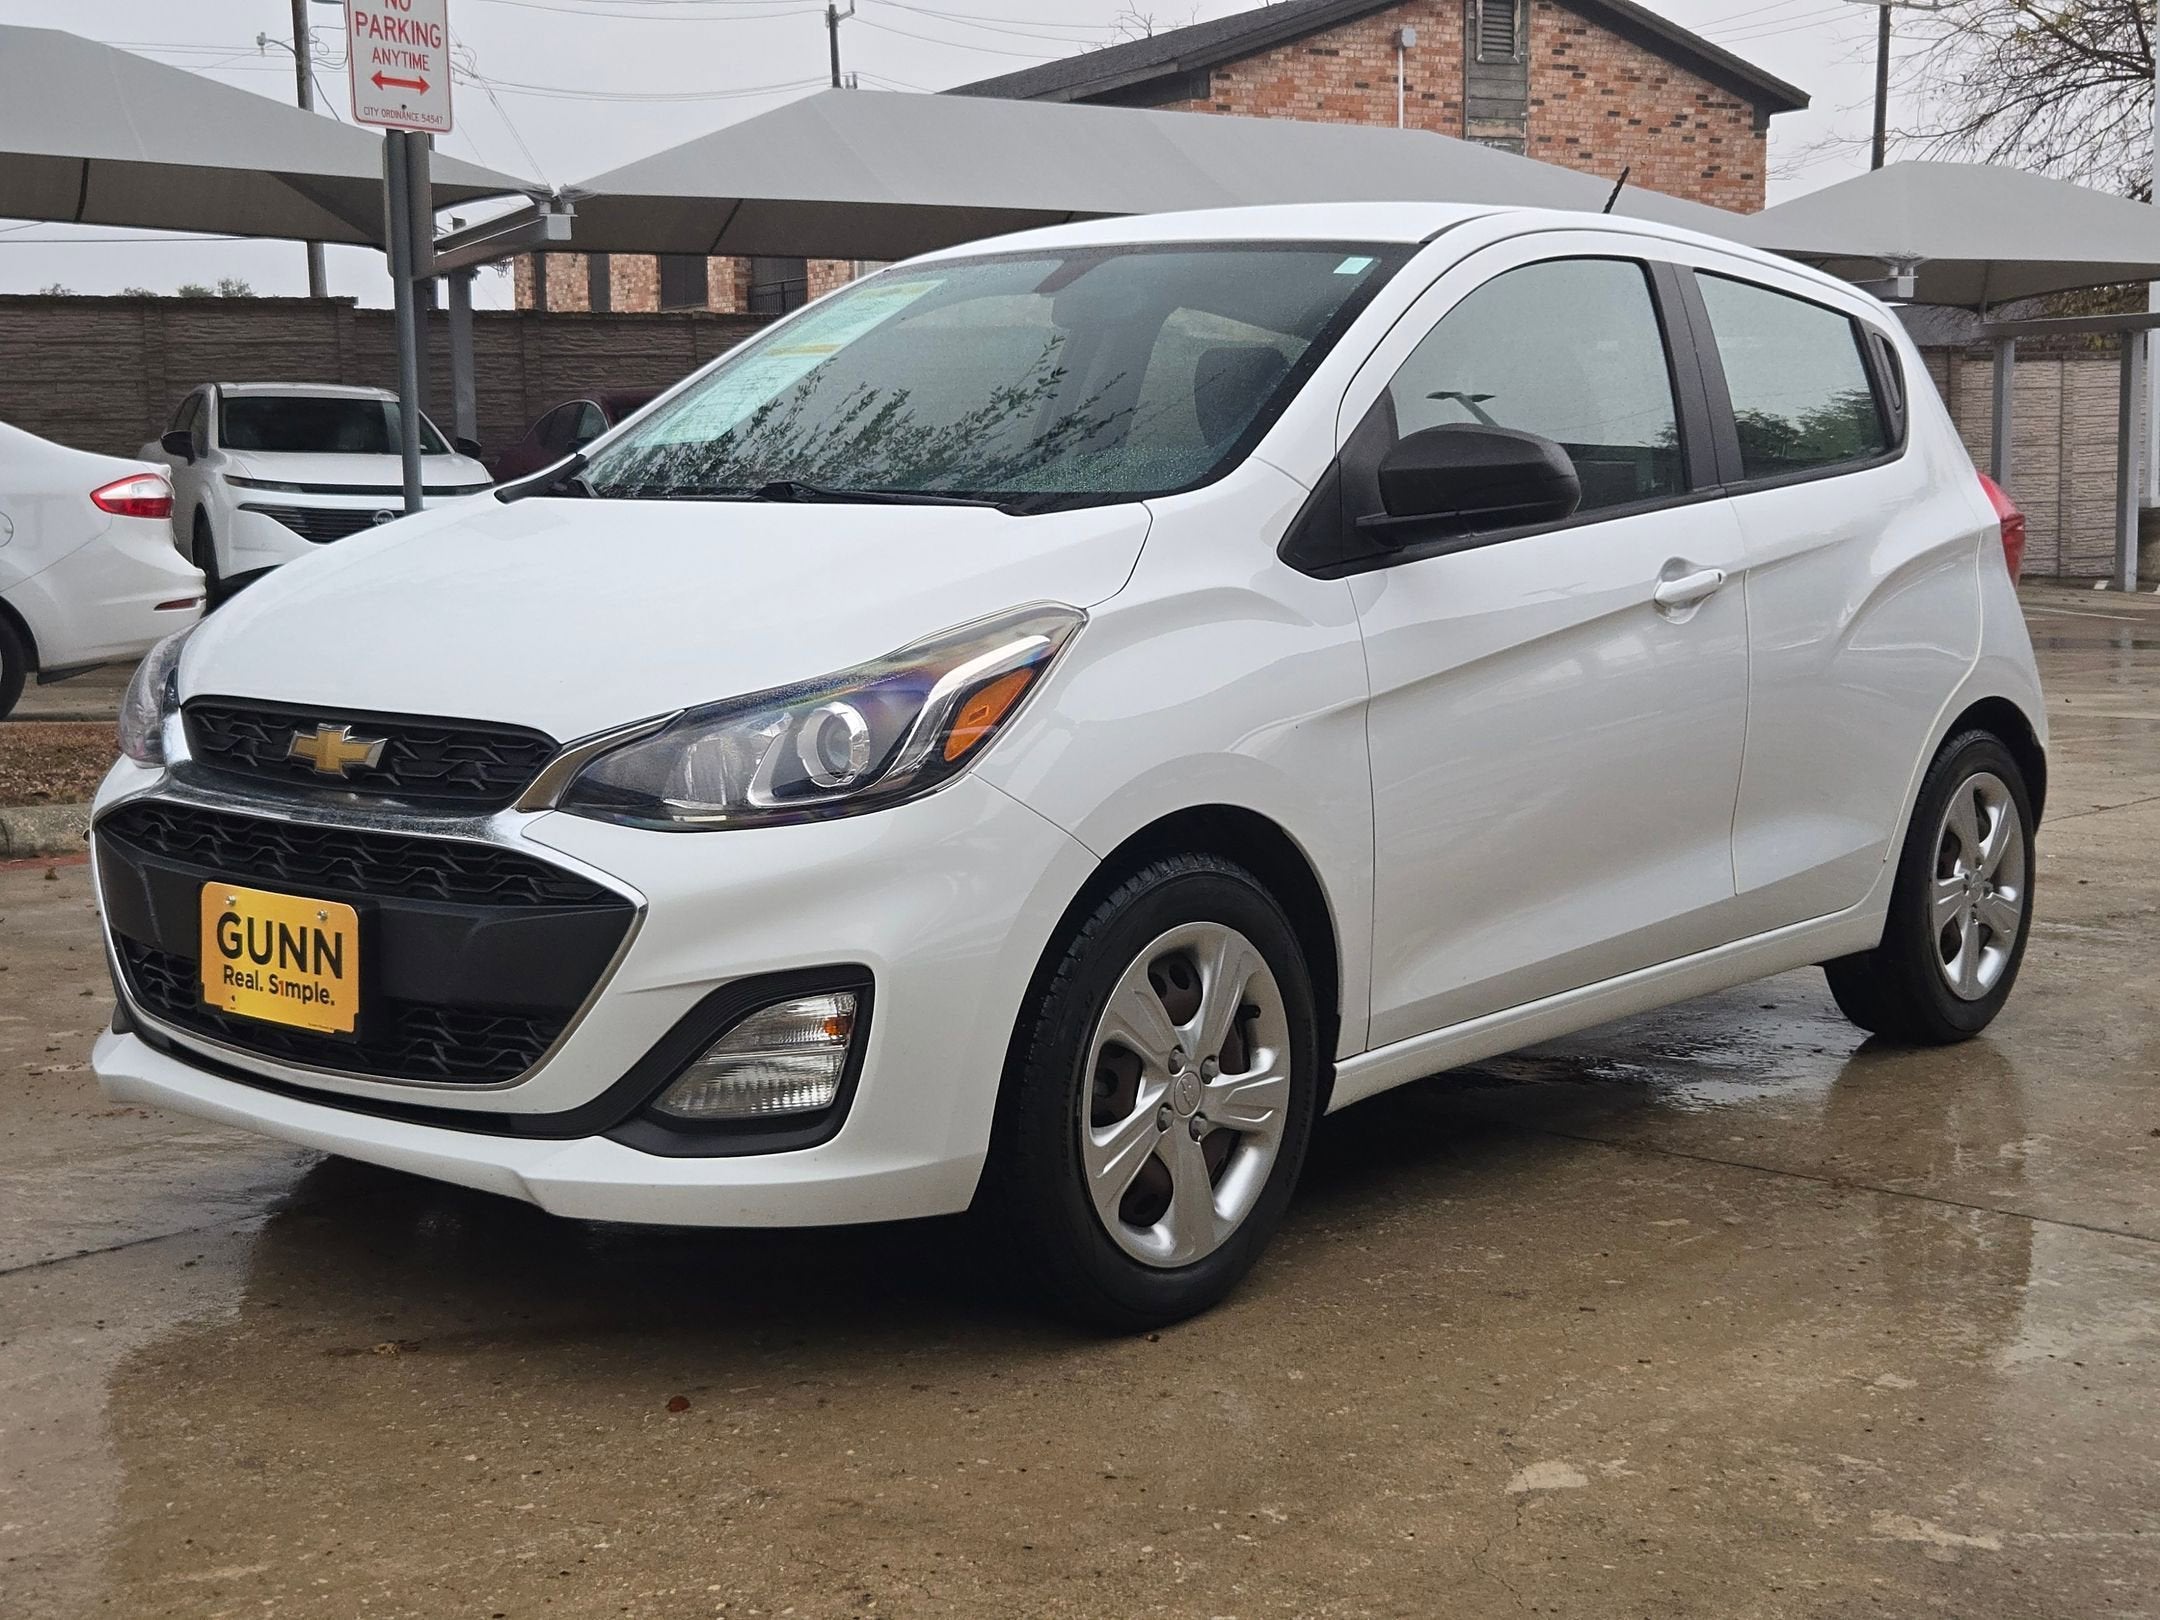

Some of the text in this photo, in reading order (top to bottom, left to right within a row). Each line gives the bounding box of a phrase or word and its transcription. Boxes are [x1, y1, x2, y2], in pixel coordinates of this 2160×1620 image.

[355, 11, 441, 49] PARKING
[372, 47, 431, 72] ANYTIME
[363, 106, 379, 117] CITY
[381, 108, 420, 122] ORDINANCE
[217, 911, 343, 980] GUNN
[223, 964, 264, 992] Real.
